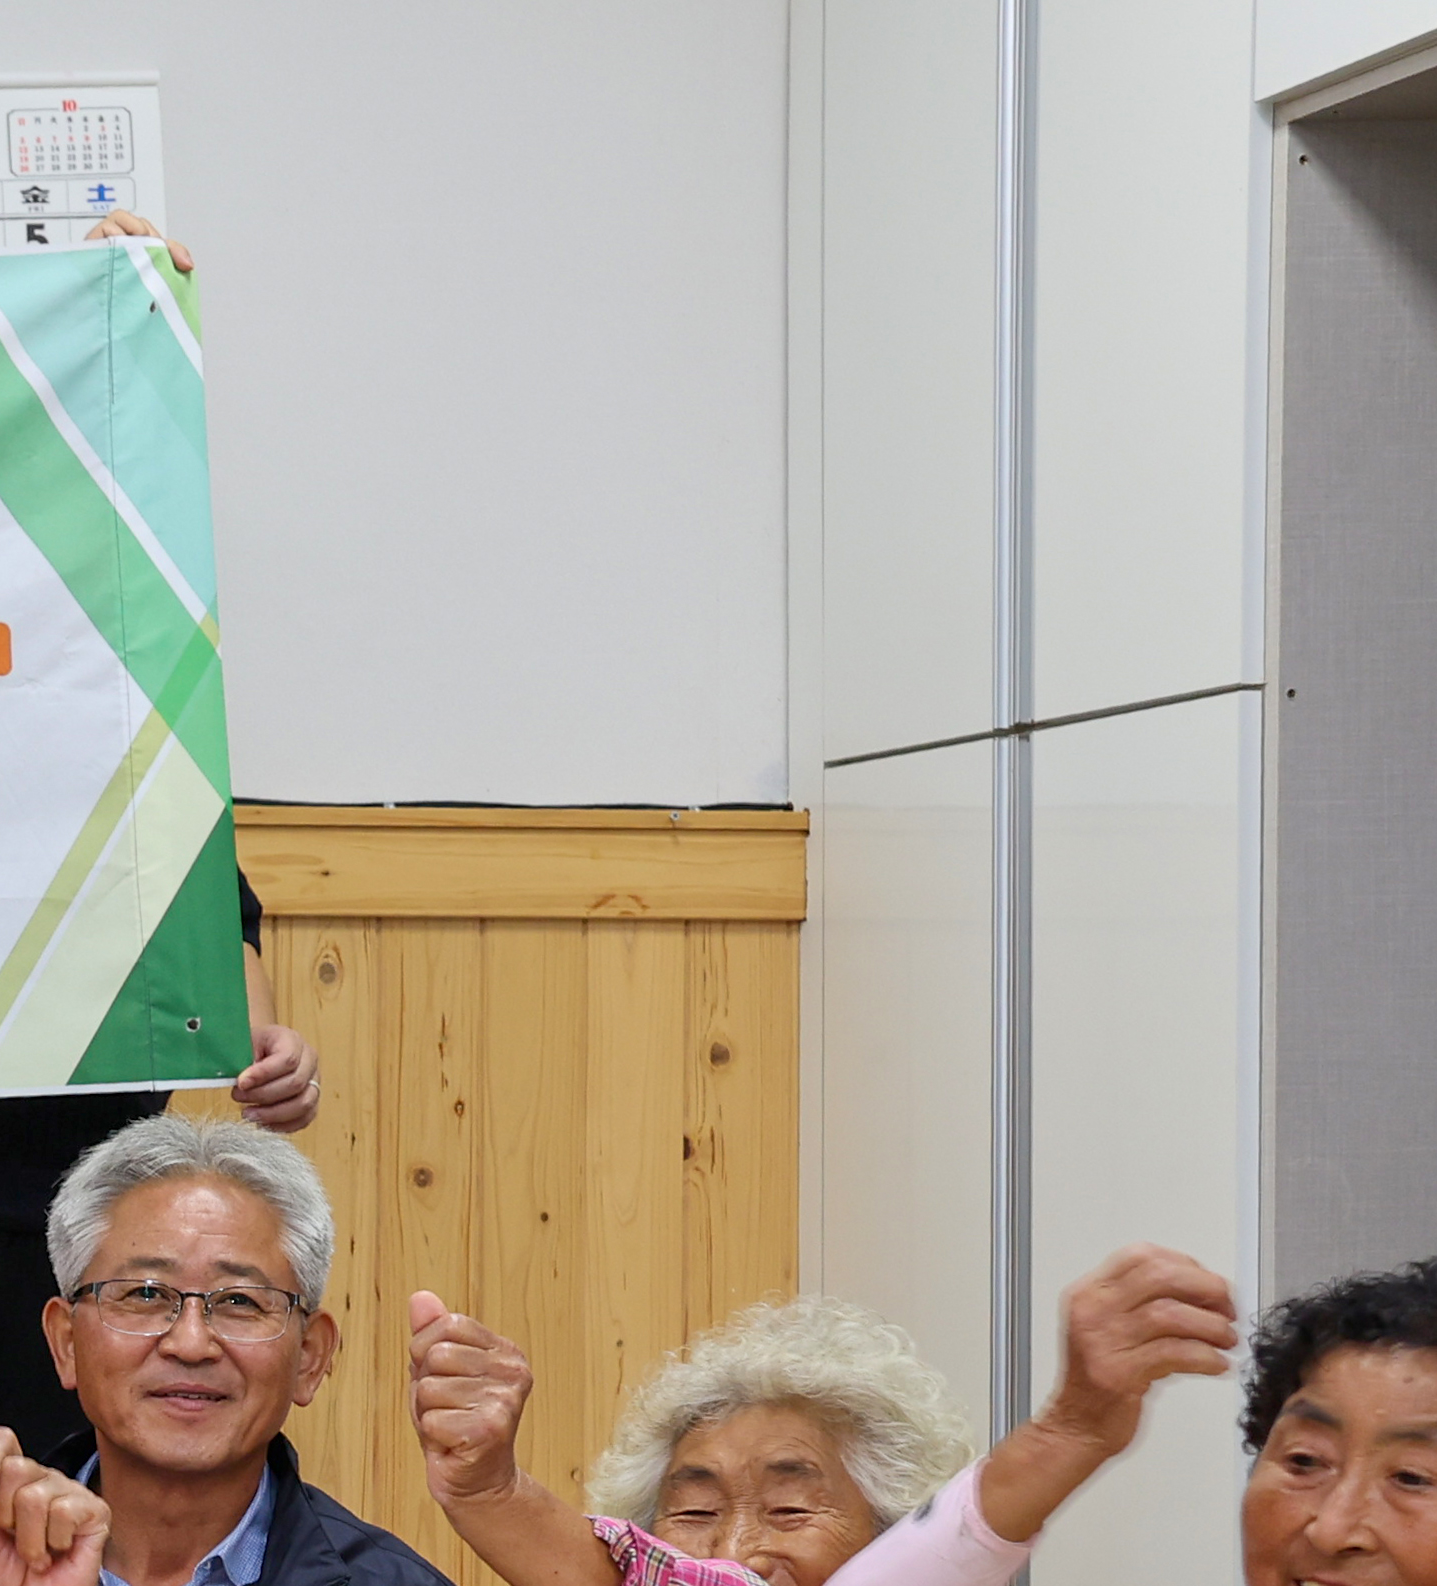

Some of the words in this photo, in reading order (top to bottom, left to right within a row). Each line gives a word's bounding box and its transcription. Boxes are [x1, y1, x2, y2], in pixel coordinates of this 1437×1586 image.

[62, 100, 77, 112] 10
[20, 185, 50, 204] 金
[87, 183, 116, 203] 土
[26, 223, 49, 244] 5
